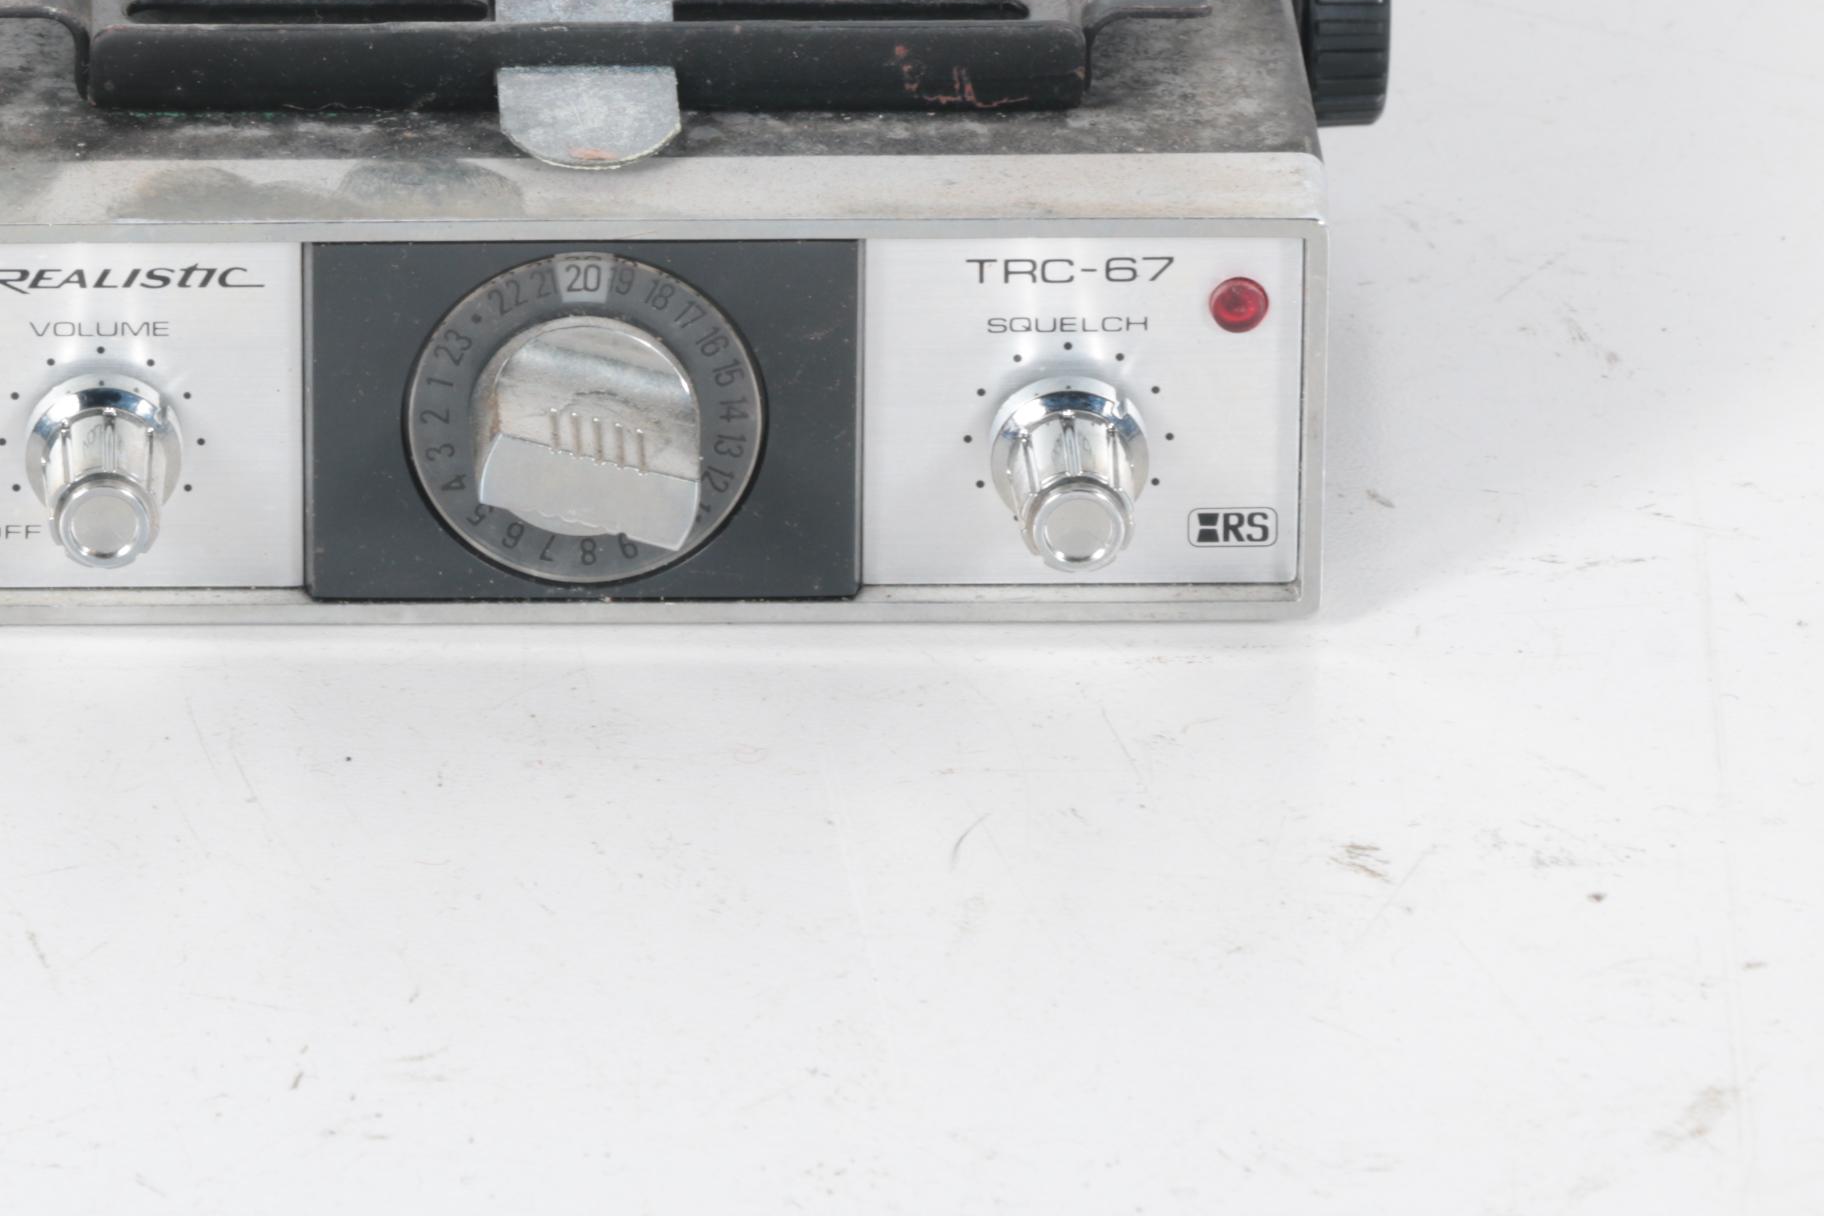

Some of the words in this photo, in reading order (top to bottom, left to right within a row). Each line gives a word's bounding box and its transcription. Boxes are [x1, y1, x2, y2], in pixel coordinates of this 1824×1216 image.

[530, 268, 558, 298] 21
[565, 264, 601, 292] 20
[609, 266, 635, 295] 19
[965, 256, 1175, 284] TRC-67
[488, 279, 528, 315] 22
[644, 279, 674, 310] 18
[674, 300, 707, 329] 17
[987, 316, 1148, 333] SQUELCH
[29, 321, 169, 337] VOLUME
[696, 326, 729, 357] 16
[434, 329, 472, 366] 23
[712, 358, 744, 387] 15
[420, 408, 450, 424] 2
[720, 396, 750, 423] 14
[427, 443, 455, 461] 3
[713, 434, 746, 458] 13
[441, 474, 466, 491] 4
[701, 465, 735, 493] 12
[502, 521, 524, 549] 6
[1222, 512, 1270, 543] RS
[539, 535, 556, 562] 7
[580, 537, 596, 565] 8
